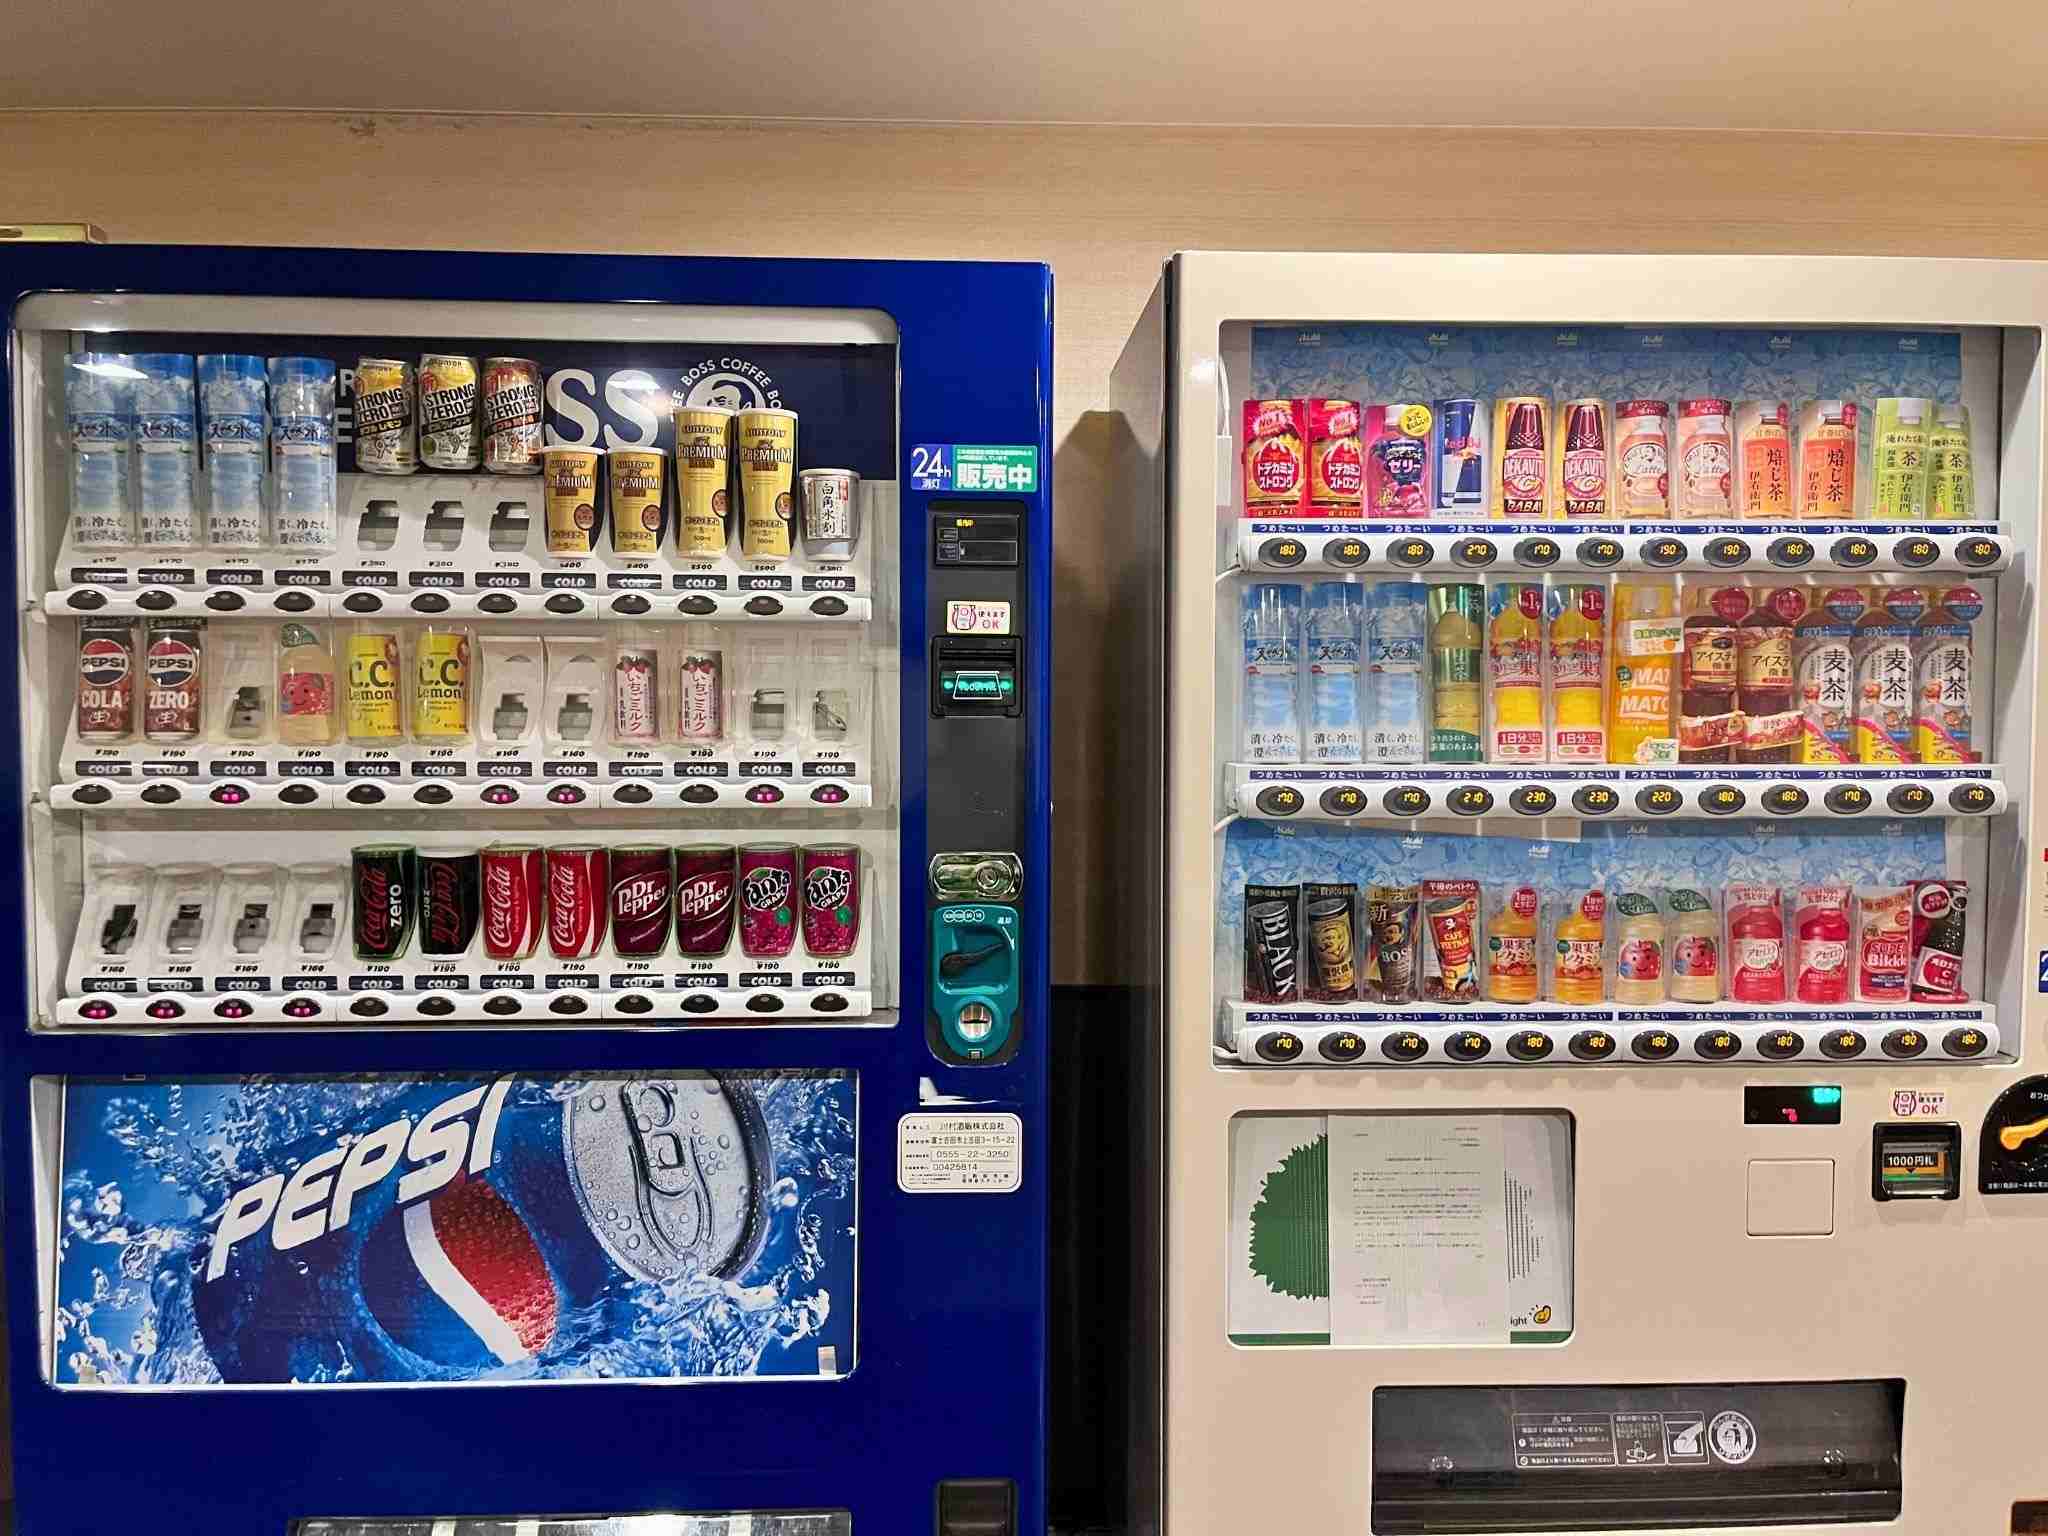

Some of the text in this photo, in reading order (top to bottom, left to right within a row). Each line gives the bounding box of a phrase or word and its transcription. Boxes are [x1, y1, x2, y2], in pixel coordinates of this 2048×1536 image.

[681, 358, 716, 386] BOSS
[721, 357, 773, 389] COFFEE
[424, 382, 476, 408] STRONG
[487, 384, 537, 409] STRONG
[429, 400, 466, 421] ZERO
[489, 402, 522, 421] ZERO
[677, 443, 728, 460] PREMIUM
[741, 446, 793, 464] PREMIUM
[1902, 450, 1917, 466] 茶
[1950, 453, 1964, 468] 茶
[957, 463, 1033, 490] 販売中
[1767, 448, 1785, 502] 焙じ茶
[1827, 448, 1844, 503] 焙じ茶
[1279, 545, 1296, 555] 180
[1343, 545, 1360, 555] 180
[1407, 545, 1424, 555] 180
[1659, 545, 1676, 555] 190
[1723, 545, 1739, 555] 190
[1787, 544, 1803, 555] 180
[1851, 544, 1866, 555] 180
[1913, 544, 1929, 555] 180
[1975, 544, 1990, 555] 180
[355, 575, 388, 585] COLD
[422, 575, 454, 586] COLD
[488, 576, 520, 586] COLD
[554, 576, 587, 587] COLD
[685, 578, 717, 588] COLD
[750, 578, 782, 588] COLD
[815, 579, 847, 588] COLD
[982, 619, 999, 630] OK
[81, 656, 126, 668] PEPSI
[148, 656, 193, 669] PEPSI
[349, 659, 395, 688] C.C.
[419, 658, 465, 687] C.C.
[1821, 648, 1847, 702] 麦茶
[1883, 648, 1907, 702] 麦茶
[1943, 648, 1967, 701] 麦茶
[80, 690, 123, 709] COLA
[148, 690, 189, 709] ZERO
[358, 765, 391, 775] COLD
[425, 765, 457, 775] COLD
[490, 765, 523, 775] COLD
[556, 765, 588, 775] COLD
[686, 765, 718, 775] COLD
[751, 765, 783, 775] COLD
[815, 765, 847, 775] COLD
[1527, 792, 1546, 802] 230
[1589, 792, 1609, 802] 230
[1652, 792, 1671, 802] 220
[1782, 791, 1797, 802] 180
[632, 879, 654, 896] Dr
[694, 879, 716, 896] Dr
[617, 884, 667, 915] Pepper
[681, 884, 729, 915] Pepper
[760, 889, 787, 909] GRAPE
[820, 888, 847, 909] GRAPE
[389, 884, 403, 929] zero
[487, 865, 513, 948] Coca-Cola
[551, 865, 577, 948] Coca-Cola
[1261, 911, 1297, 996] BLACK
[562, 963, 585, 971] ¥190
[757, 962, 779, 970] ¥190
[361, 979, 393, 990] COLD
[427, 979, 459, 989] COLD
[492, 978, 524, 989] COLD
[557, 978, 589, 988] COLD
[686, 976, 718, 987] COLD
[750, 976, 782, 986] COLD
[1922, 1104, 1939, 1115] OK
[1888, 1155, 1936, 1167] 1000円札
[206, 1074, 517, 1283] PEPSI
[1510, 1315, 1528, 1328] ight
